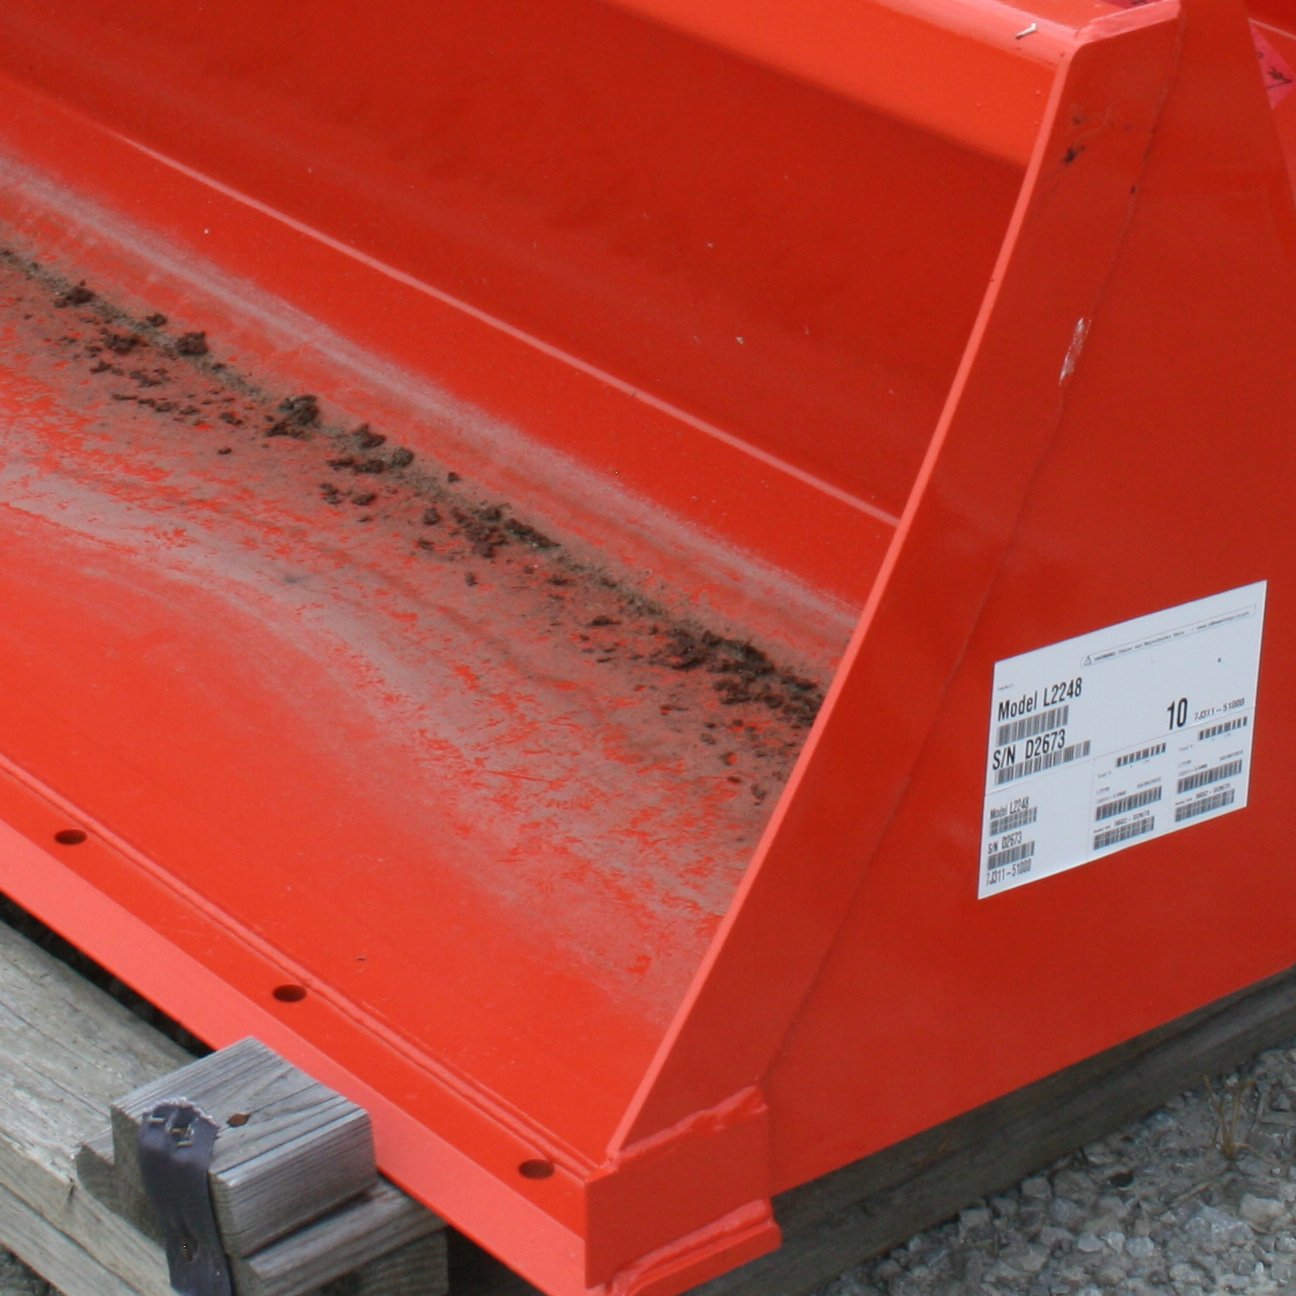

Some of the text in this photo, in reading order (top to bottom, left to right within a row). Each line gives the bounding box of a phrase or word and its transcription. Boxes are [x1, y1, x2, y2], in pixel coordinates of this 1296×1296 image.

[997, 676, 1083, 722] Model L2248
[1166, 697, 1189, 731] 10
[992, 729, 1066, 771] S/N D2673
